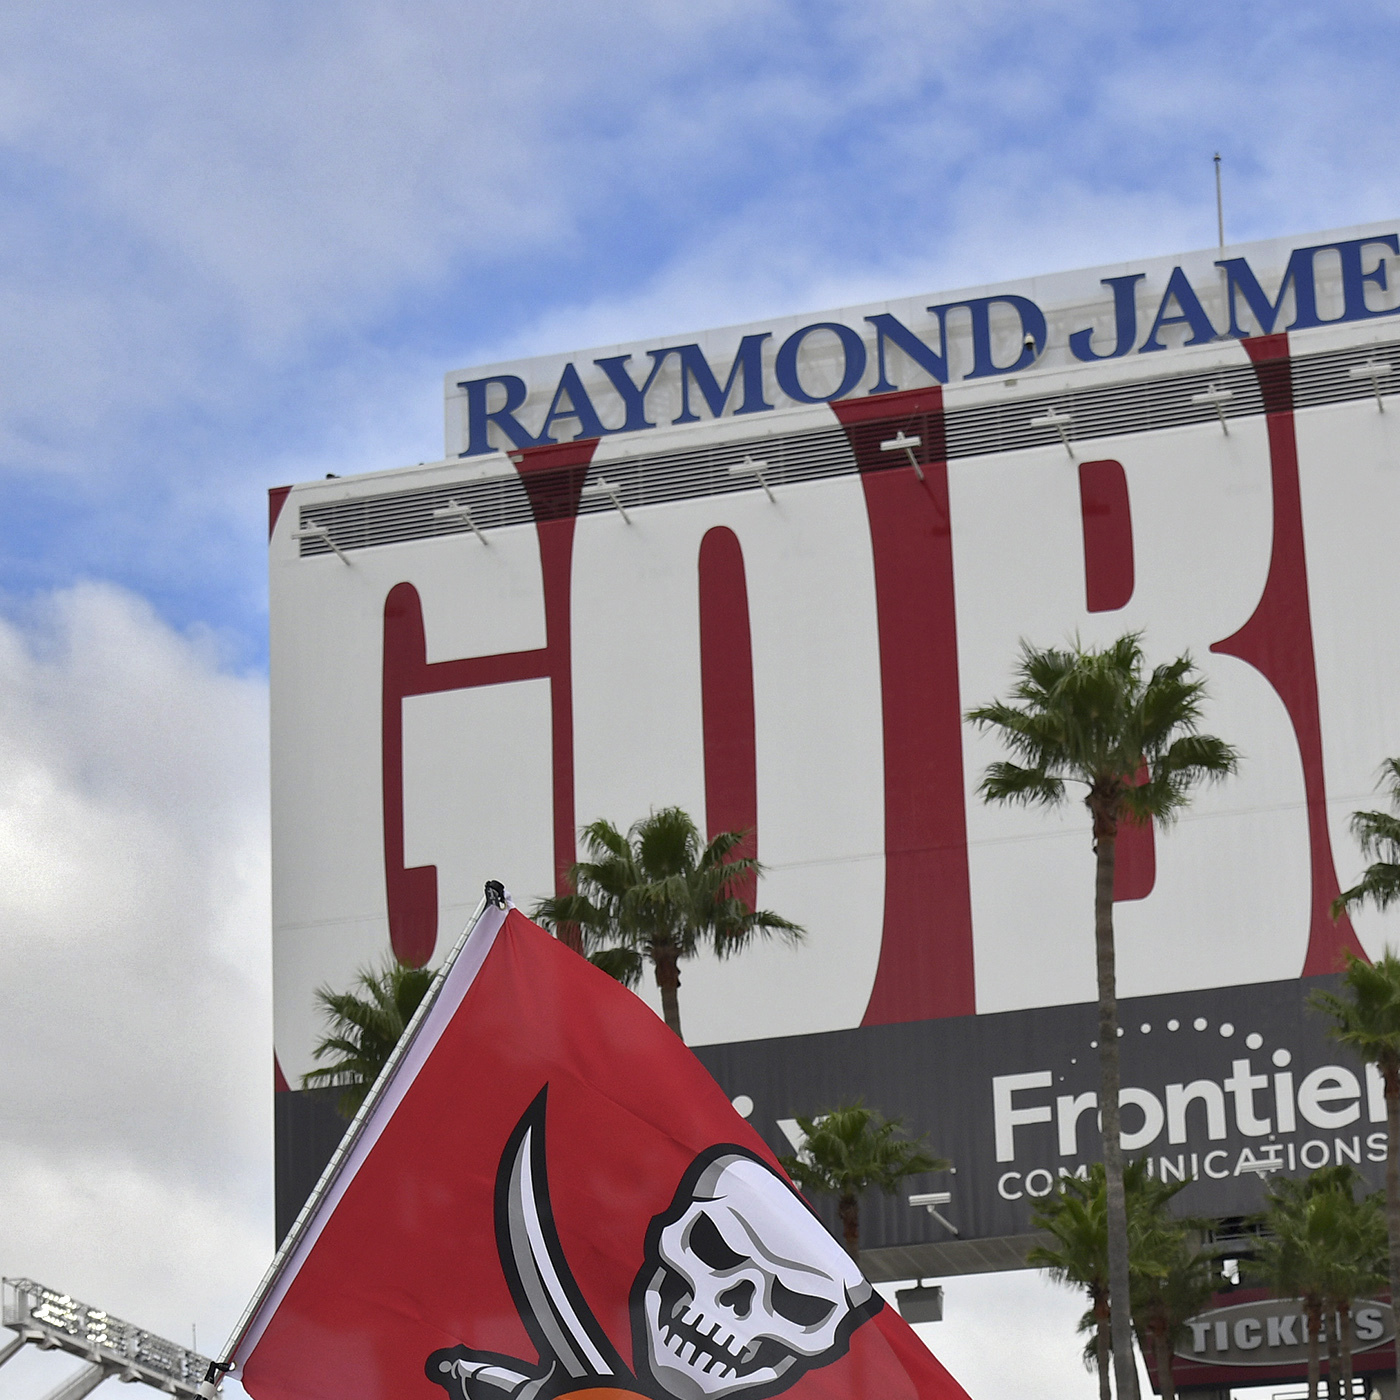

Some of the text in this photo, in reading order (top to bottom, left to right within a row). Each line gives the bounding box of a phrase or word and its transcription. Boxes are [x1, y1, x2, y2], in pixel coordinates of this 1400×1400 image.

[457, 294, 1047, 458] RAYMOND
[269, 402, 887, 1092] GO
[998, 1132, 1388, 1200] COMNICATIONS
